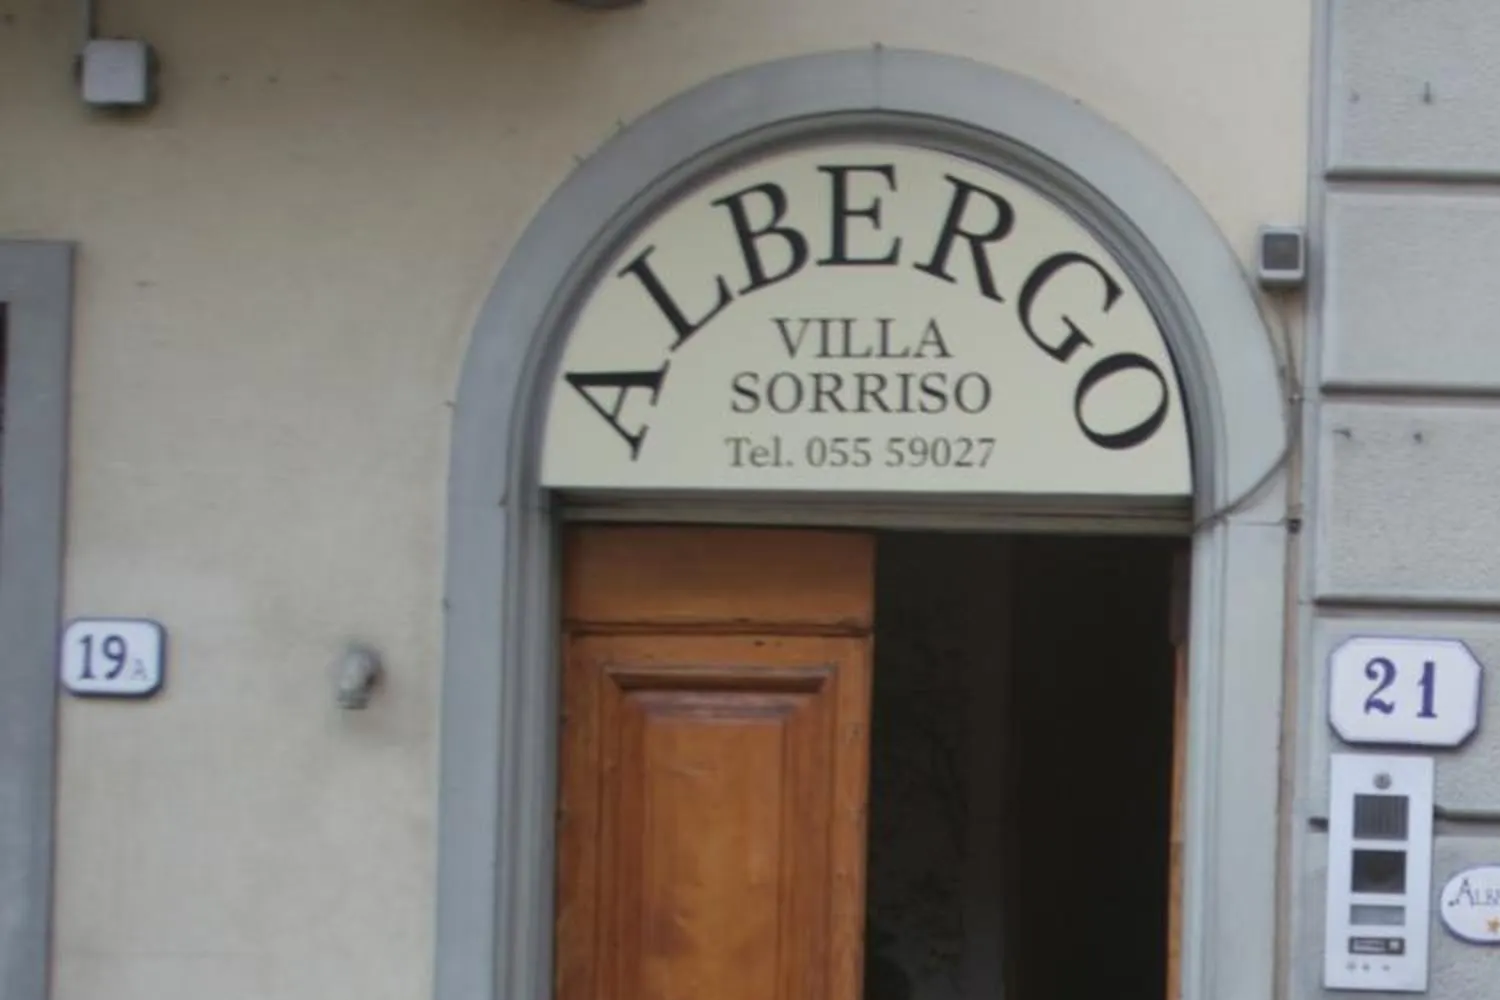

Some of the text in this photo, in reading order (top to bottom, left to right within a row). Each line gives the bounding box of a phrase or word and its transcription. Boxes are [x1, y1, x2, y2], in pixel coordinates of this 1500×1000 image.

[563, 162, 1170, 460] ALBERGO
[771, 317, 954, 359] VILLA
[730, 371, 992, 414] SORRISO
[724, 436, 996, 469] Tel. 055 59027
[1363, 656, 1438, 718] 21
